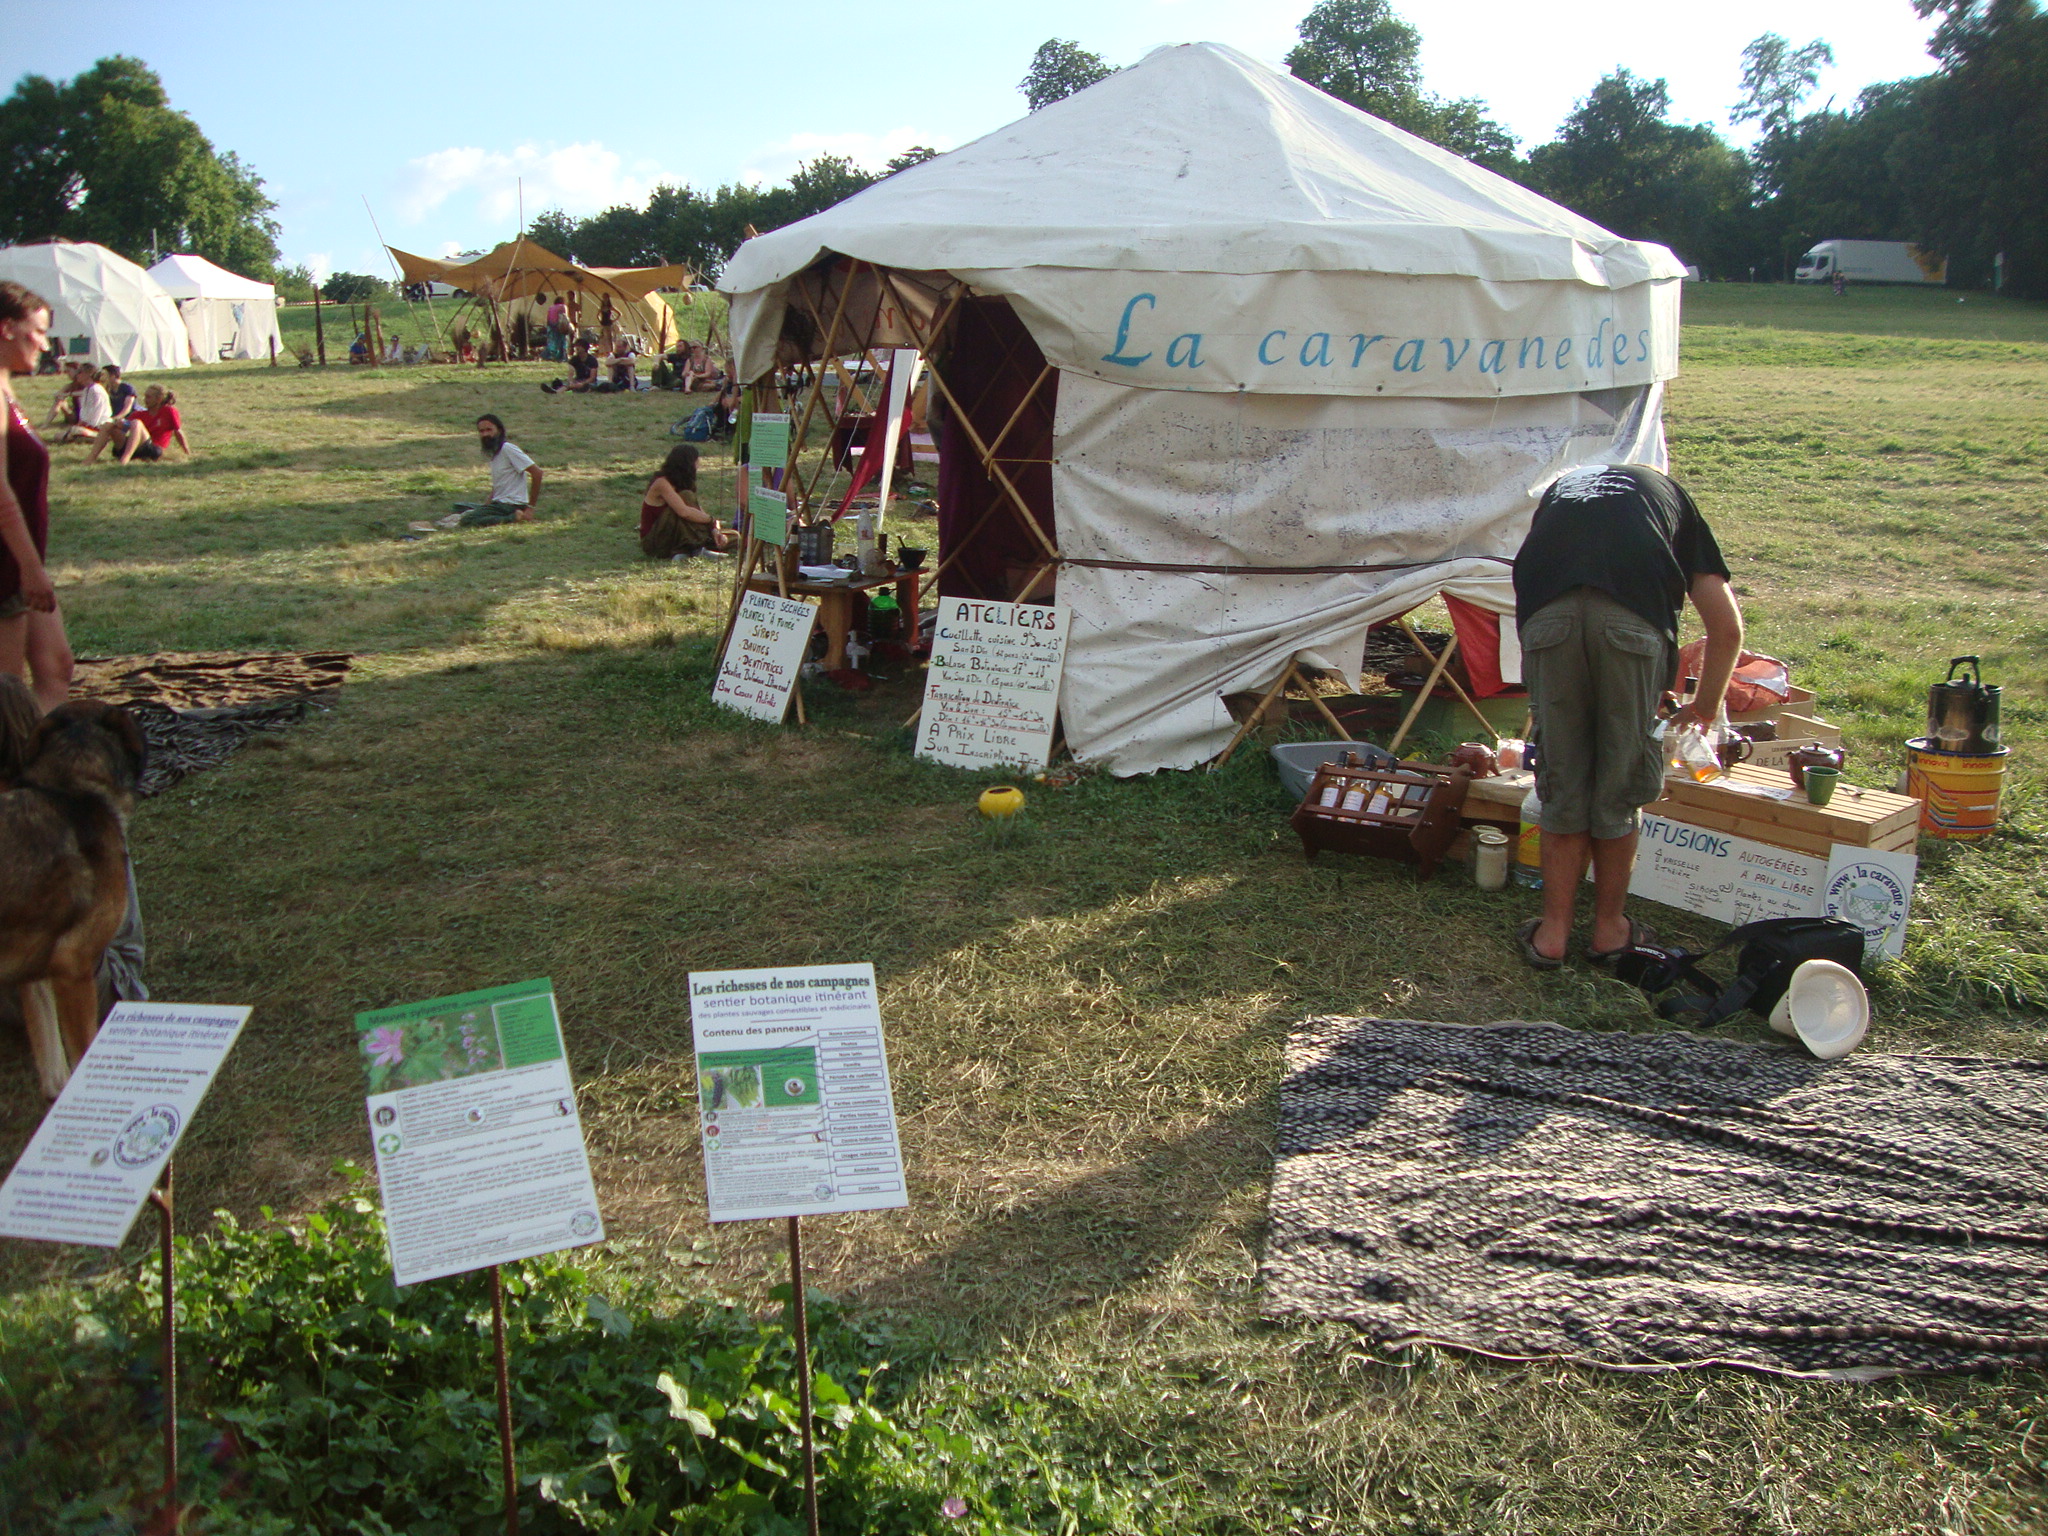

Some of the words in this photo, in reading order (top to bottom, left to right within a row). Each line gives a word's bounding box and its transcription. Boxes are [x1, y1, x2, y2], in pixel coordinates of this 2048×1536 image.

[1100, 292, 1205, 368] La
[1257, 327, 1571, 374] caravane
[1586, 317, 1649, 369] des
[749, 594, 776, 609] PLANTES
[741, 608, 765, 622] PLANTES
[1756, 757, 1770, 767] DE
[1771, 756, 1784, 766] LA
[1962, 759, 1993, 769] innova
[1739, 851, 1808, 876] AUTOGÉRÉES
[1754, 873, 1776, 885] PRIX
[1781, 881, 1814, 896] LIBRE
[1869, 870, 1904, 906] caravane
[692, 982, 714, 997] Les
[715, 979, 768, 994] richesses
[770, 976, 784, 990] de
[786, 979, 806, 989] nos
[807, 976, 871, 991] campagnes
[703, 996, 747, 1009] sentier
[749, 993, 812, 1007] botanique
[814, 989, 868, 1002] itinérant
[712, 1009, 740, 1020] plantes
[702, 1026, 744, 1039] Contenu
[745, 1026, 763, 1036] des
[763, 1024, 812, 1037] panneaux
